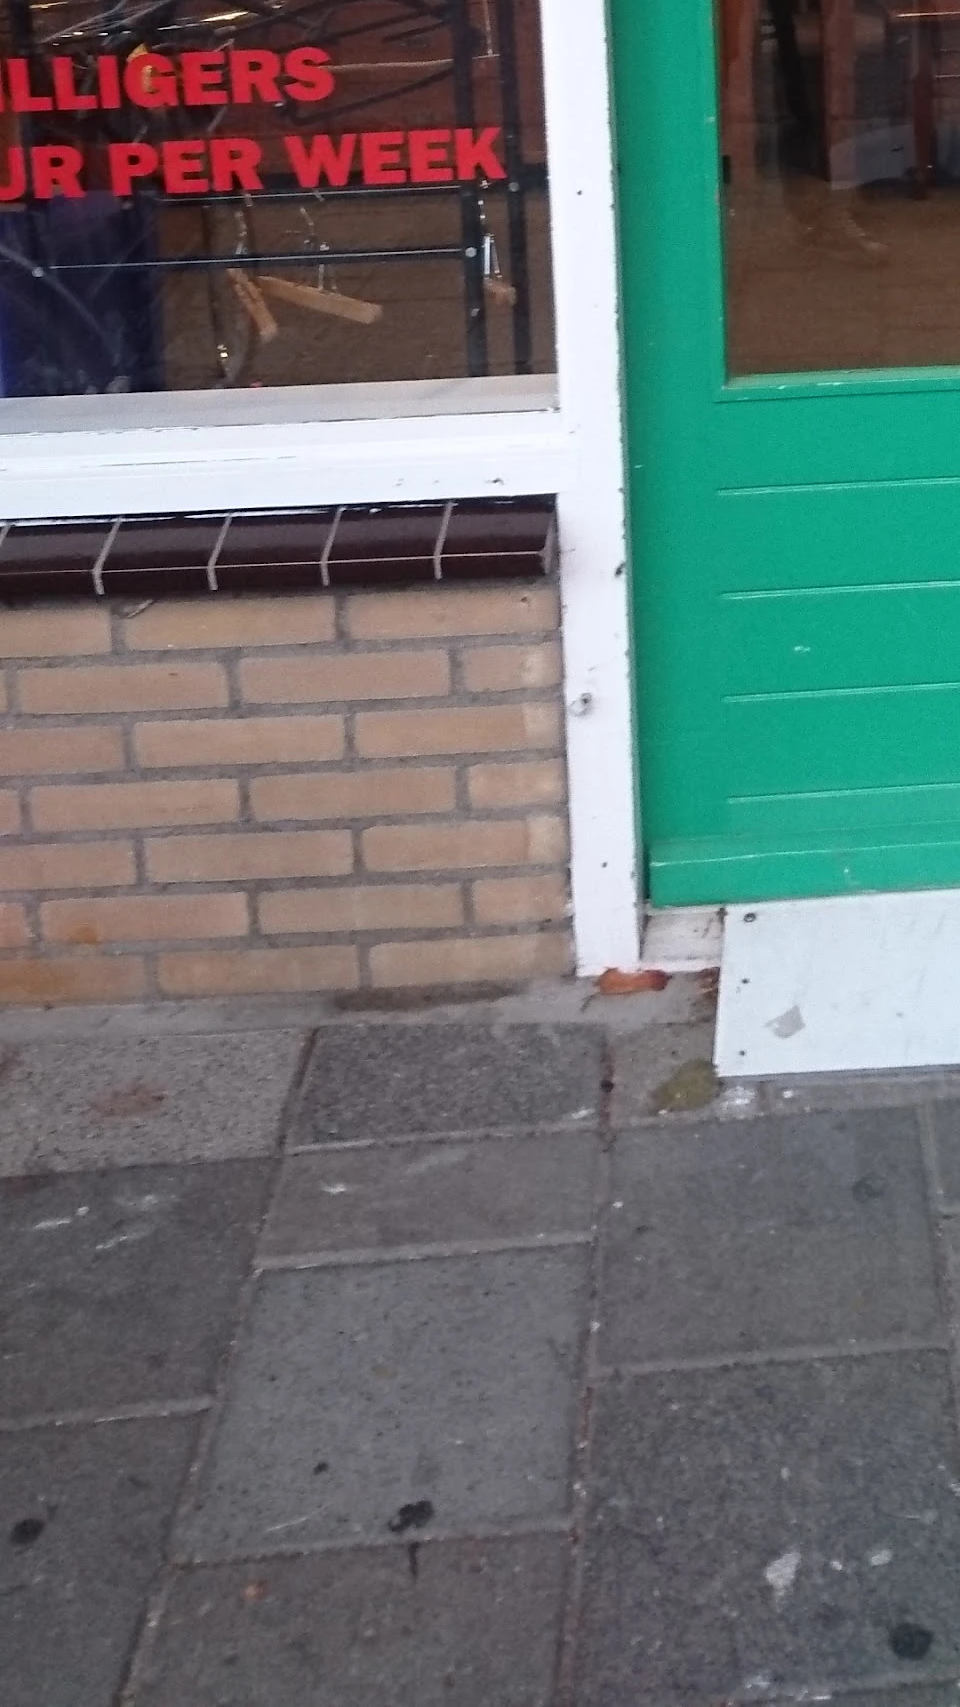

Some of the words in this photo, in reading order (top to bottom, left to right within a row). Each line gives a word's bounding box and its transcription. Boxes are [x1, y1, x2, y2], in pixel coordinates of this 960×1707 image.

[0, 46, 337, 113] LLIGERS
[107, 138, 264, 196] PER
[283, 127, 509, 189] WEEK
